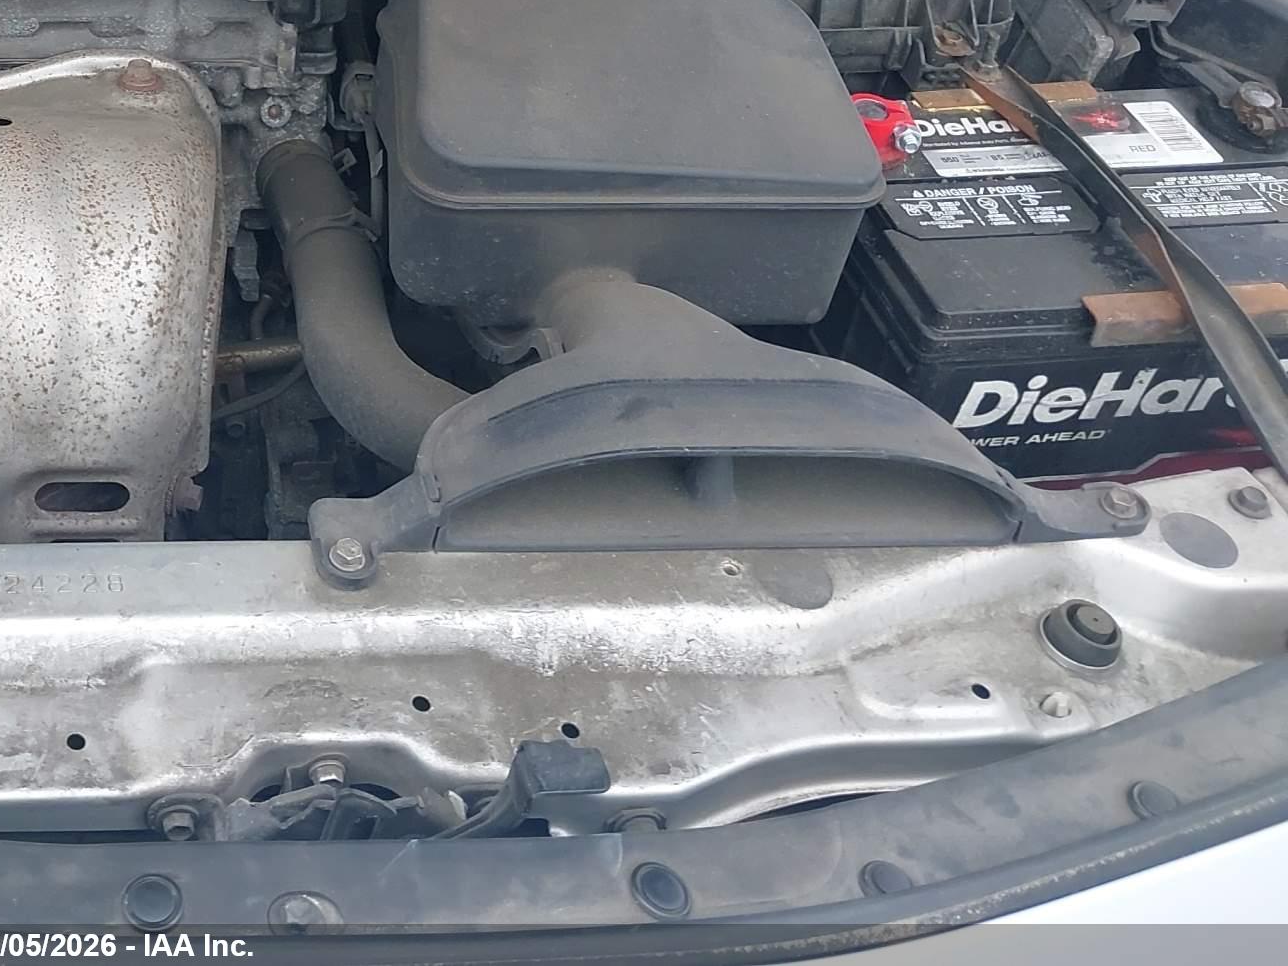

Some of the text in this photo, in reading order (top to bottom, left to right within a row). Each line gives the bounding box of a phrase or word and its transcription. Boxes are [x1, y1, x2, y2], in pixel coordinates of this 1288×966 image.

[1128, 144, 1157, 153] RED
[924, 187, 975, 198] DANGER
[987, 184, 1036, 195] POISON
[952, 367, 1236, 429] DieHar
[1024, 429, 1107, 445] AHEAD
